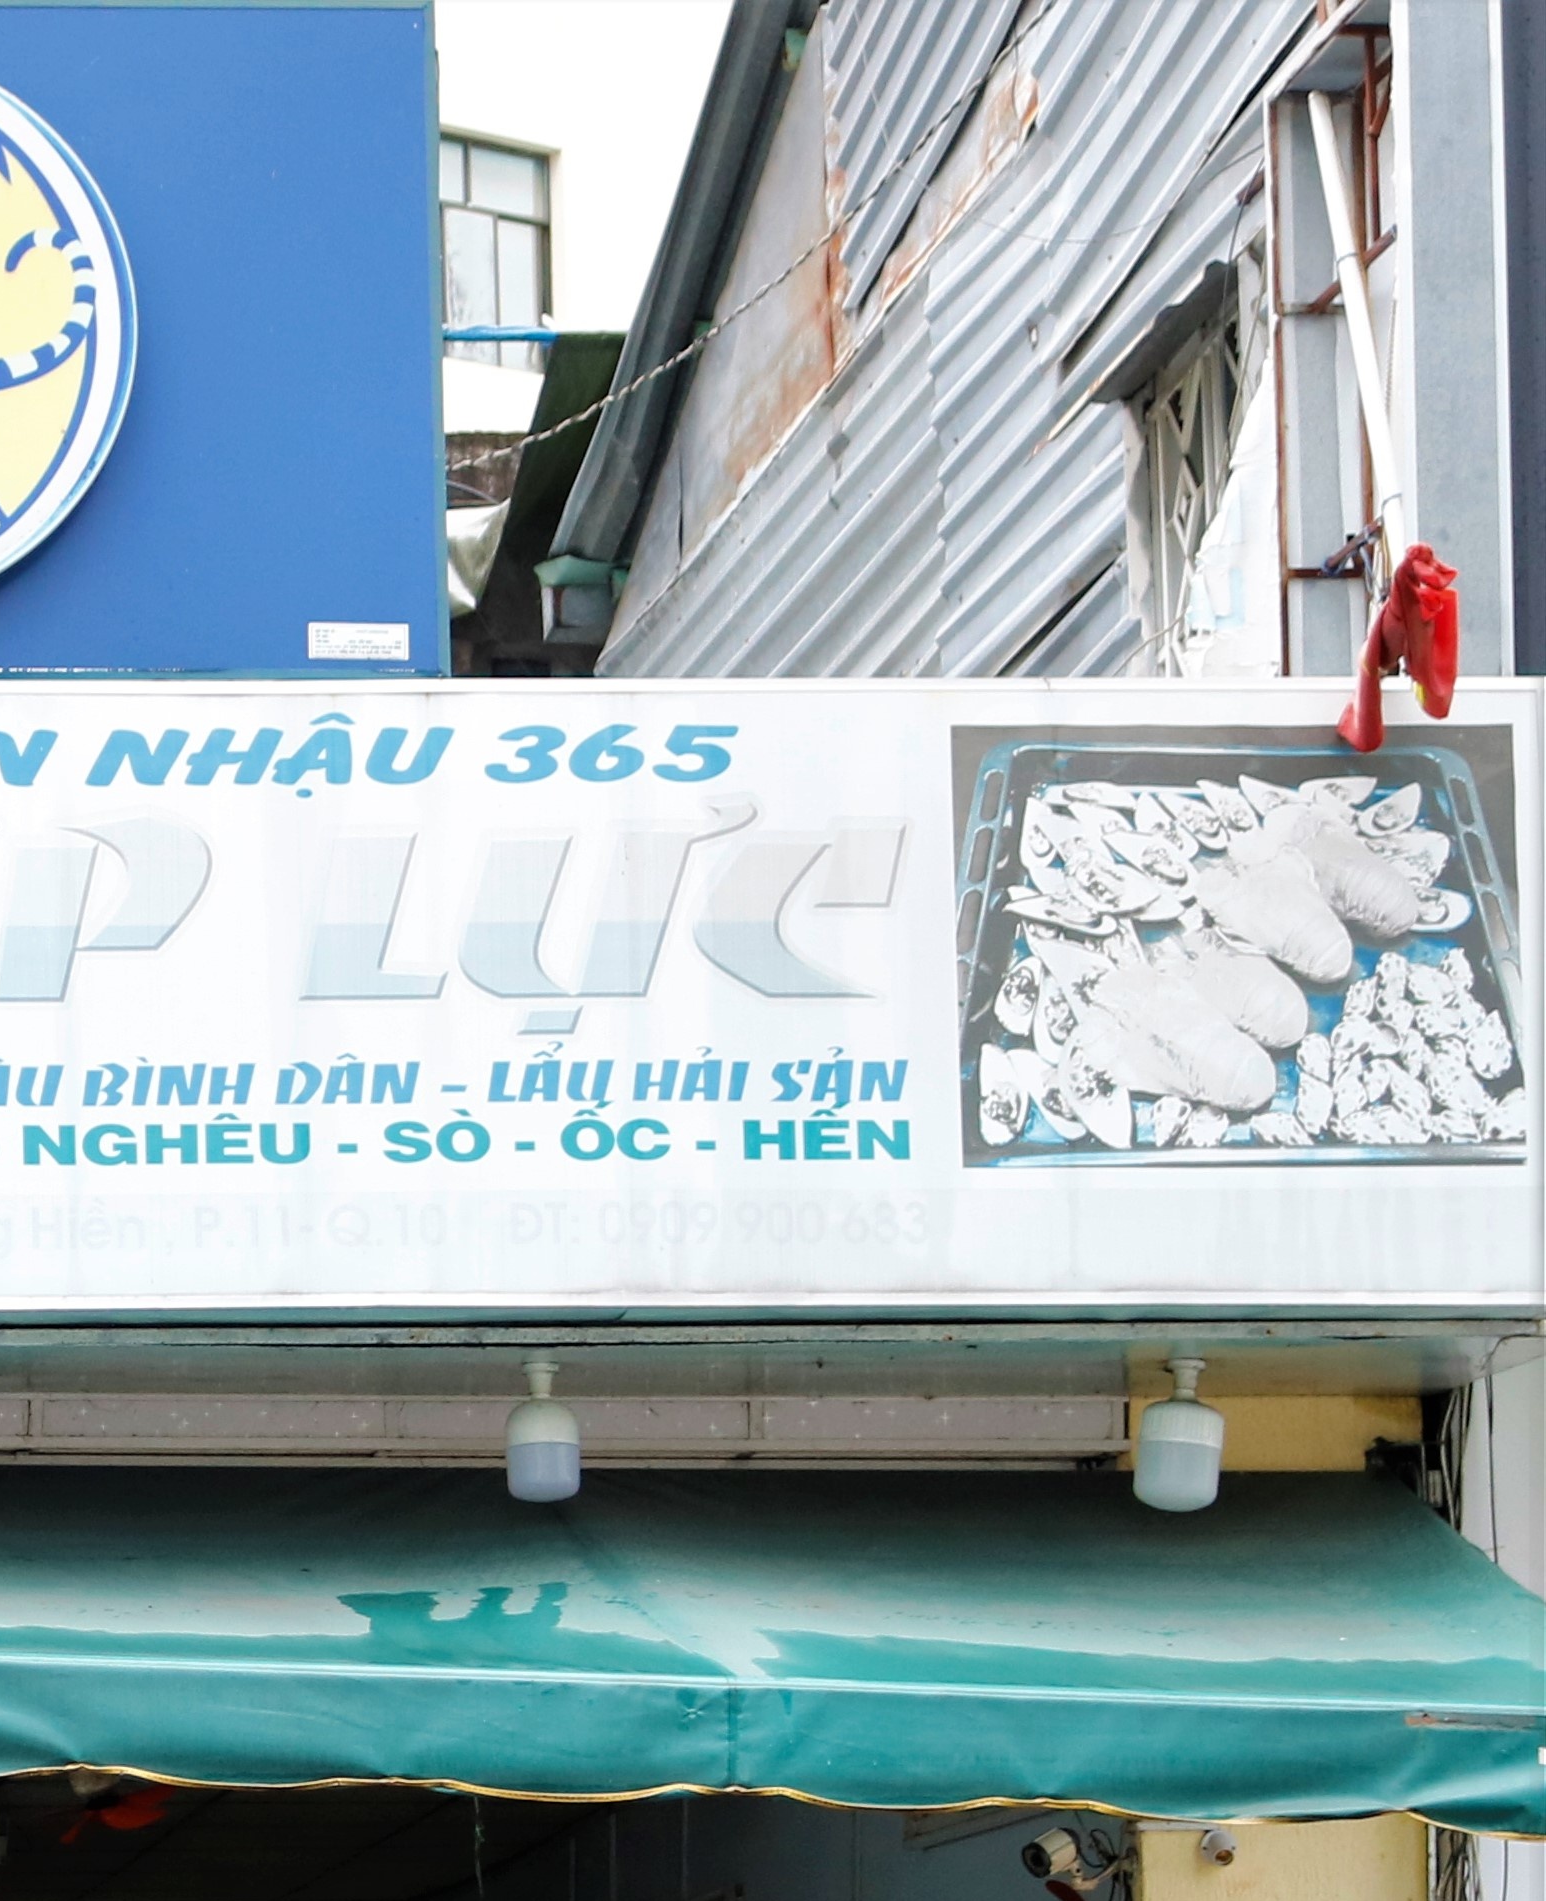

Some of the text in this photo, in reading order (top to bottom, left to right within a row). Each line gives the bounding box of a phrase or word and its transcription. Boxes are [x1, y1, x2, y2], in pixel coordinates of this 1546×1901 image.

[85, 711, 455, 798] NHẬU
[484, 725, 740, 783] 365
[300, 793, 905, 1037] LỰC
[82, 1054, 254, 1107] BÌNH
[274, 1050, 422, 1106] DÂN
[633, 1047, 750, 1101] HẢI
[772, 1046, 908, 1103] SẢN
[23, 1113, 309, 1168] NGHÊU
[382, 1107, 491, 1162] SÒ
[561, 1100, 671, 1161] ỐC
[597, 1201, 717, 1245] 0909
[735, 1201, 831, 1245] 900
[840, 1201, 931, 1245] 683
